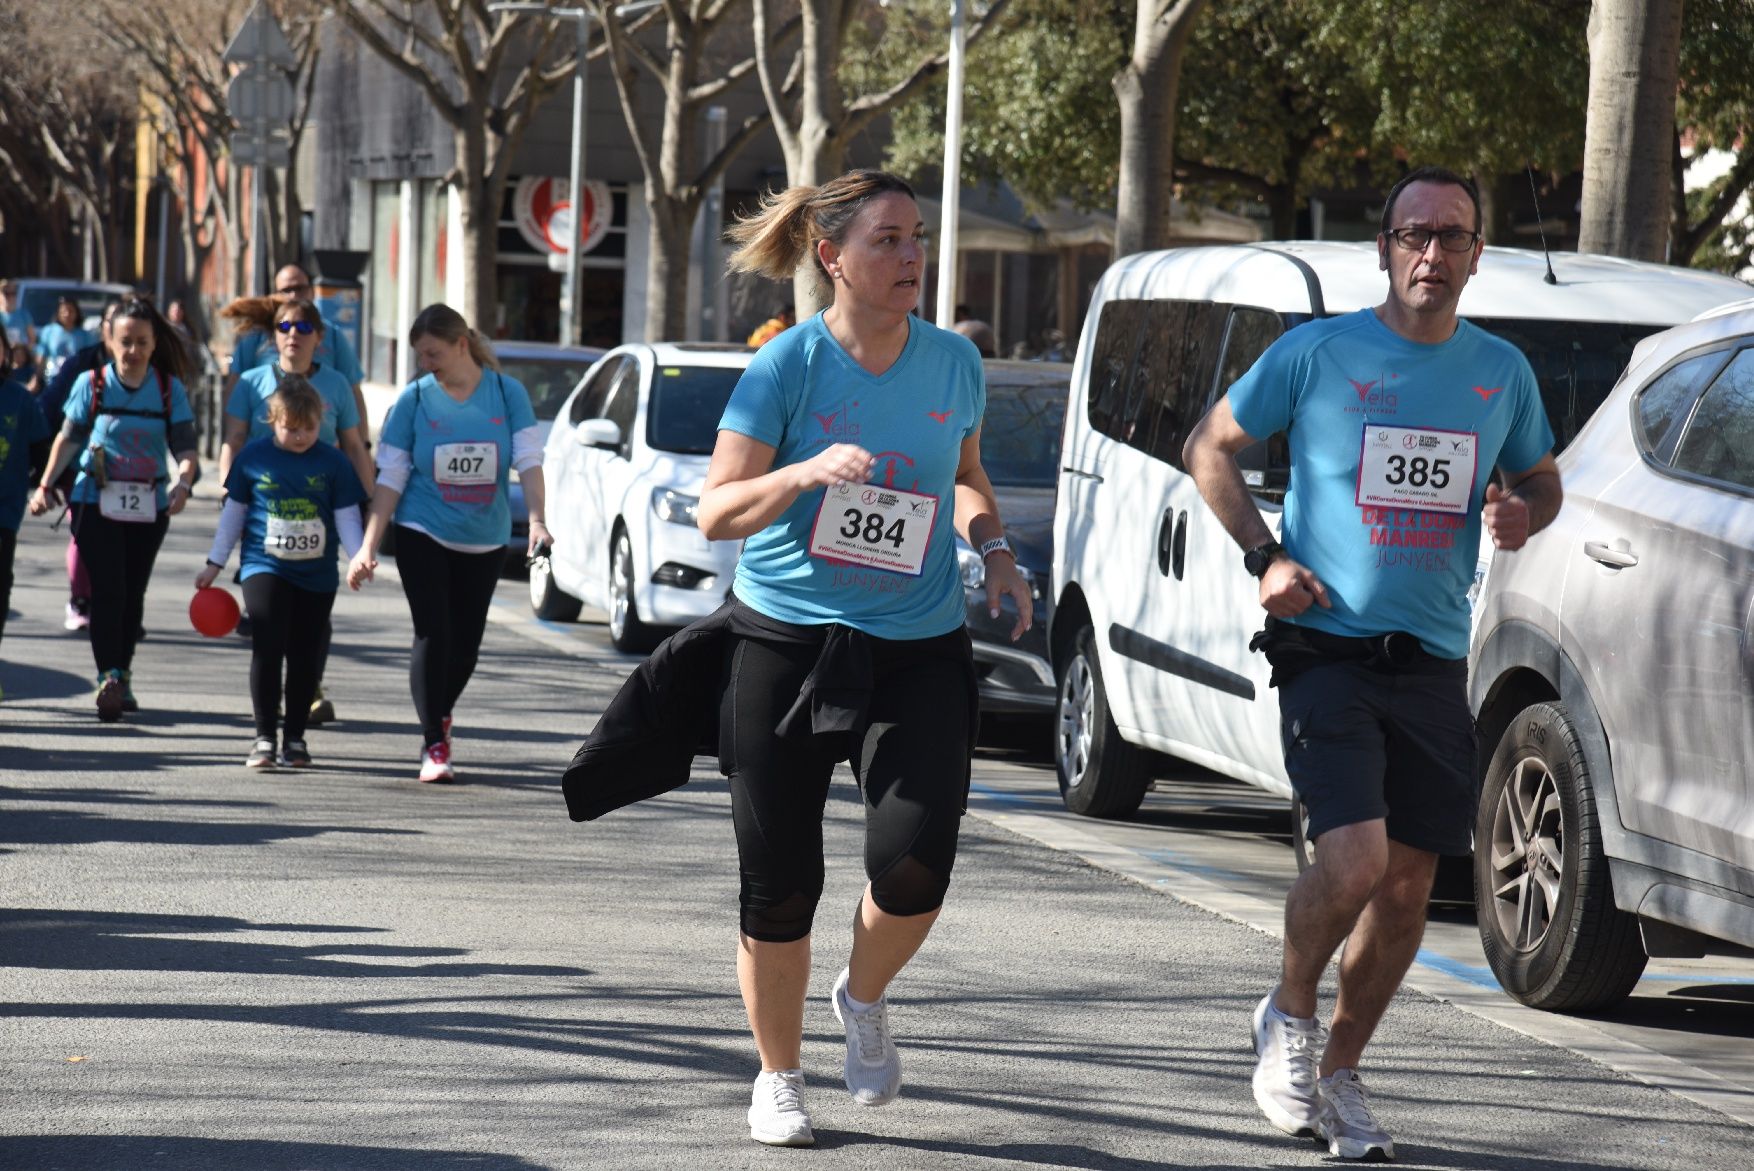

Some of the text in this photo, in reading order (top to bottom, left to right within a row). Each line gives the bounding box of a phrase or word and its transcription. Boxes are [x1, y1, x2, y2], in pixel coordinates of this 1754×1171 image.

[448, 457, 483, 473] 407
[1385, 454, 1450, 489] 385
[119, 495, 140, 510] 12
[840, 508, 906, 548] 384
[275, 534, 320, 551] 1039
[1526, 720, 1547, 745] IRIS
